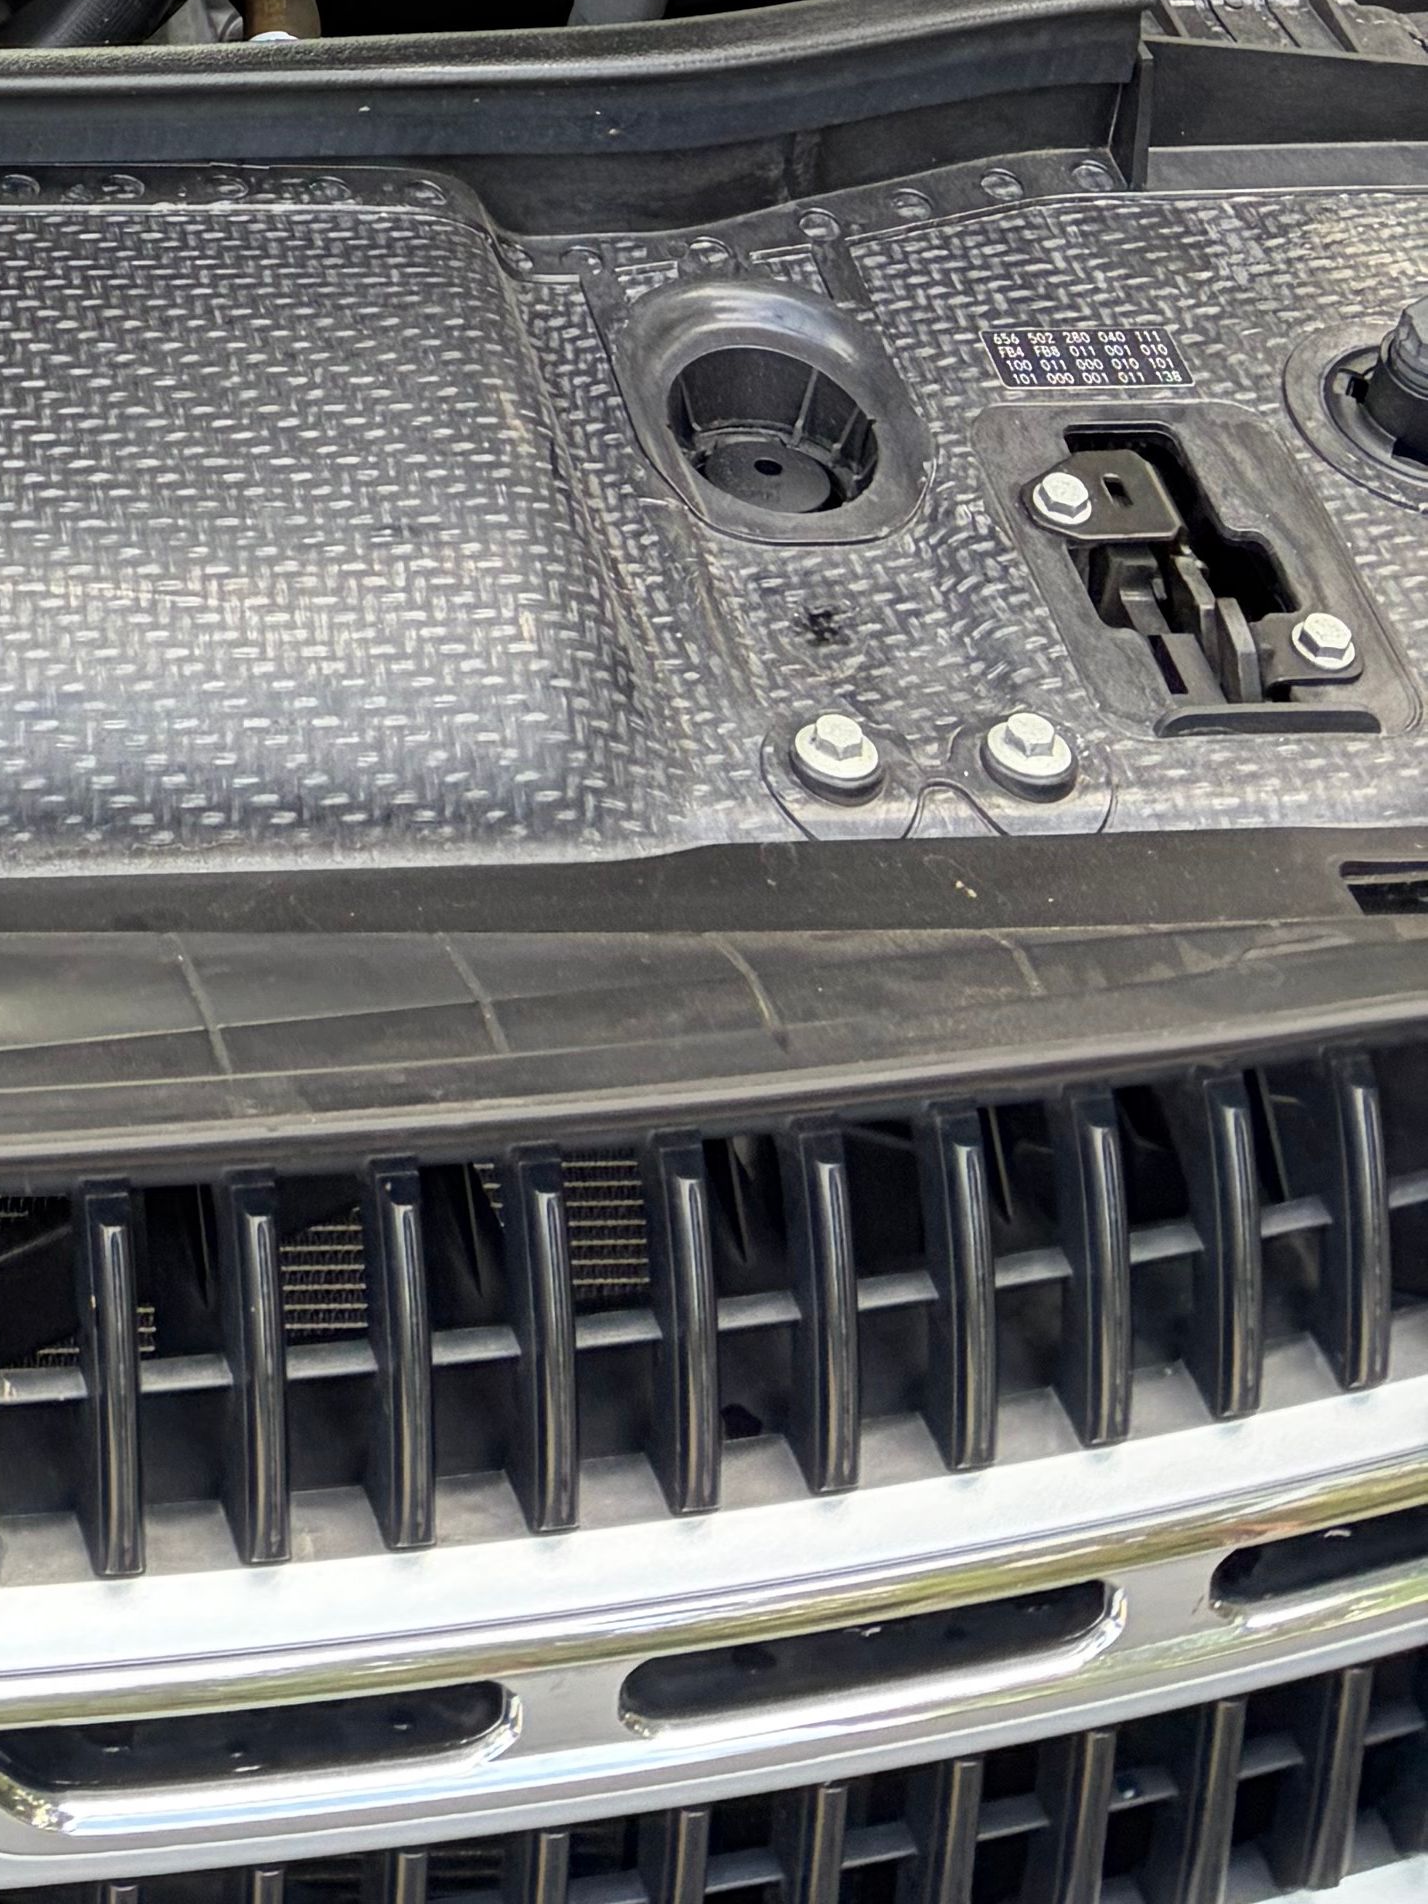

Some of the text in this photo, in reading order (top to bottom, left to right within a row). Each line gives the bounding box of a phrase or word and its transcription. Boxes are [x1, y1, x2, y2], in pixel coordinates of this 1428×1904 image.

[993, 332, 1020, 345] 656
[1027, 332, 1055, 344] 502
[1098, 331, 1126, 343] 040
[1135, 330, 1161, 342] 111
[998, 344, 1168, 358] FB4 FB8 011 001 010
[1006, 357, 1175, 372] 100 011 000 010 101
[1012, 373, 1039, 385] 101
[1047, 372, 1075, 384] 000
[1082, 372, 1110, 384] 001
[1118, 371, 1145, 383] 011
